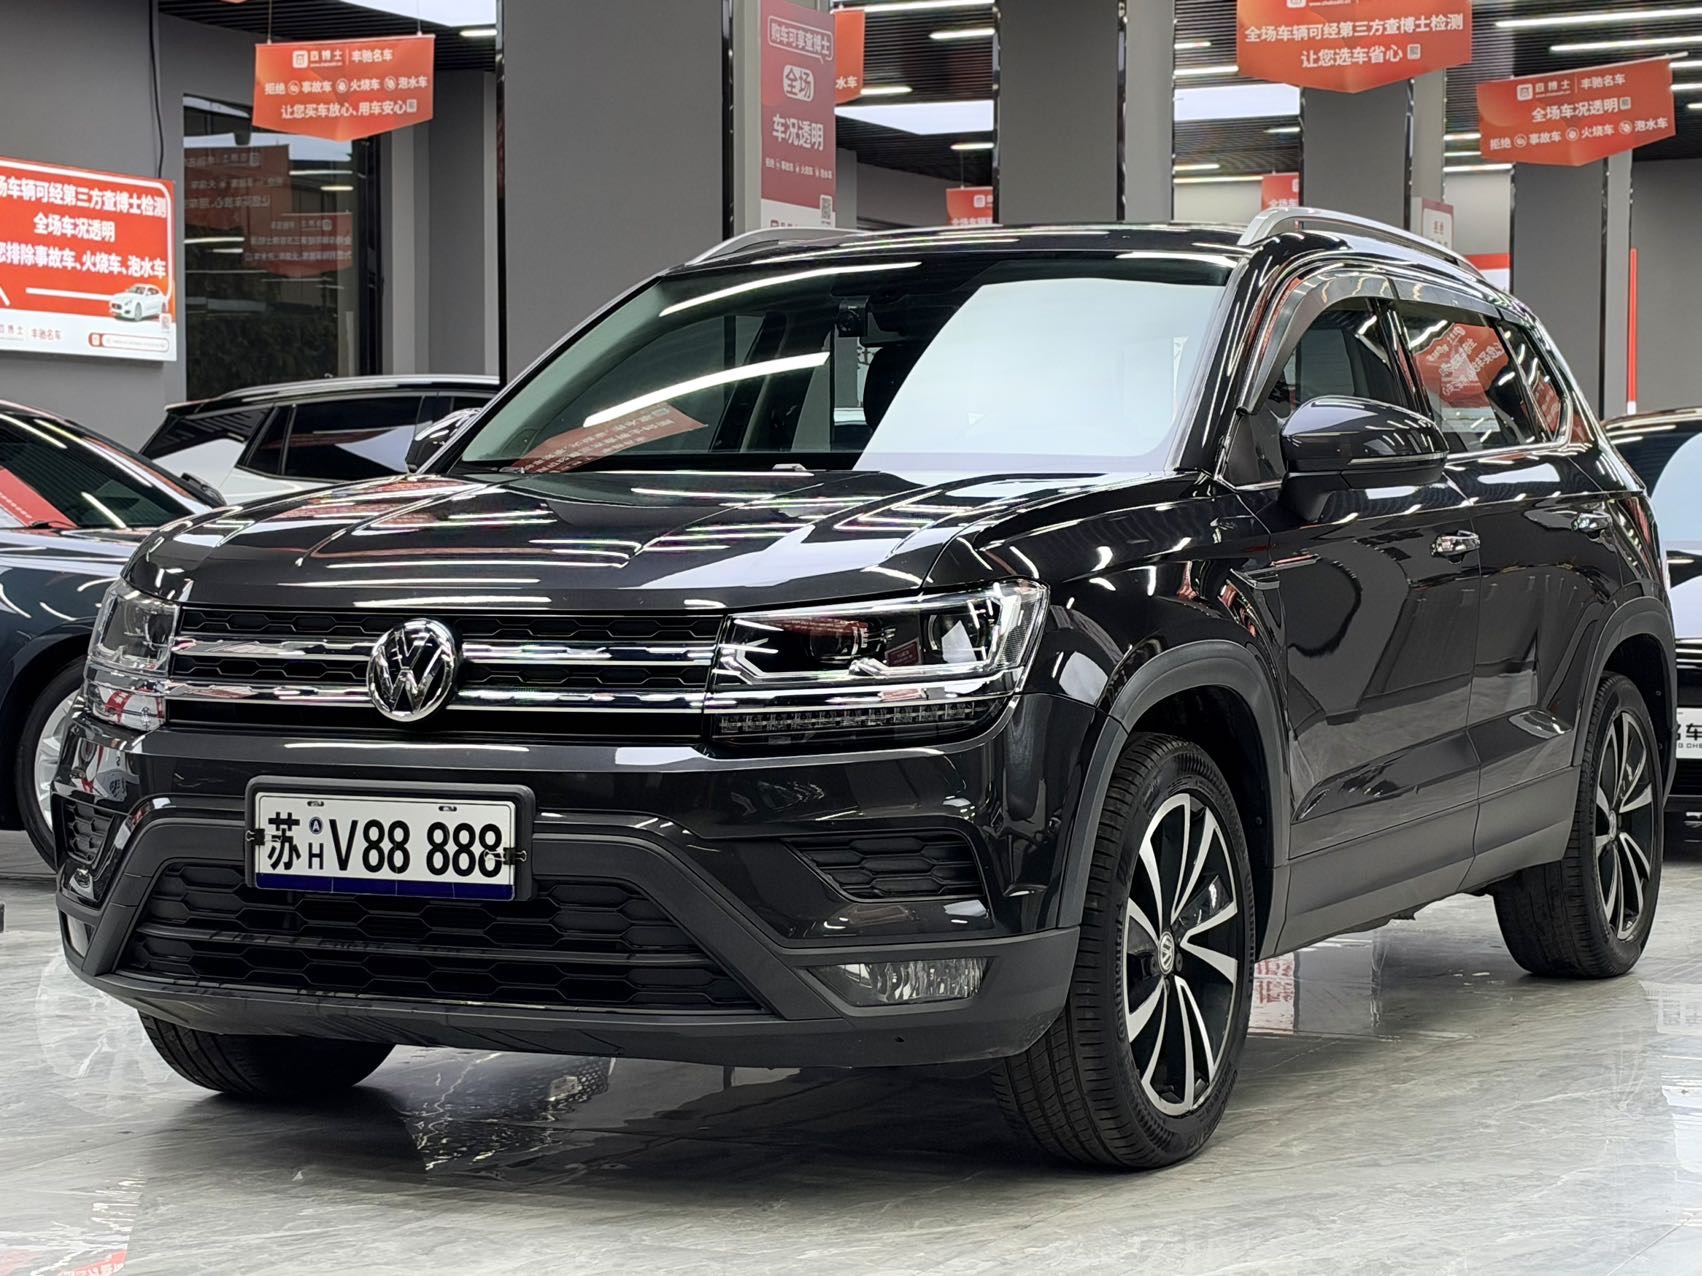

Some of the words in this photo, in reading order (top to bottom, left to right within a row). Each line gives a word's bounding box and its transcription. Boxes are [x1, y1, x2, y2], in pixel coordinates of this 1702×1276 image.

[771, 22, 830, 55] 购车可享查博士
[1245, 13, 1464, 42] 全场车辆可经第三方查博士检测
[1301, 44, 1403, 68] 让您选车省心
[785, 66, 813, 100] 全场
[281, 100, 406, 119] 让您买车放心、用车安心
[1531, 97, 1618, 123] 全场车况透明
[772, 113, 824, 151] 车况透明
[33, 211, 115, 242] 全场车况透明
